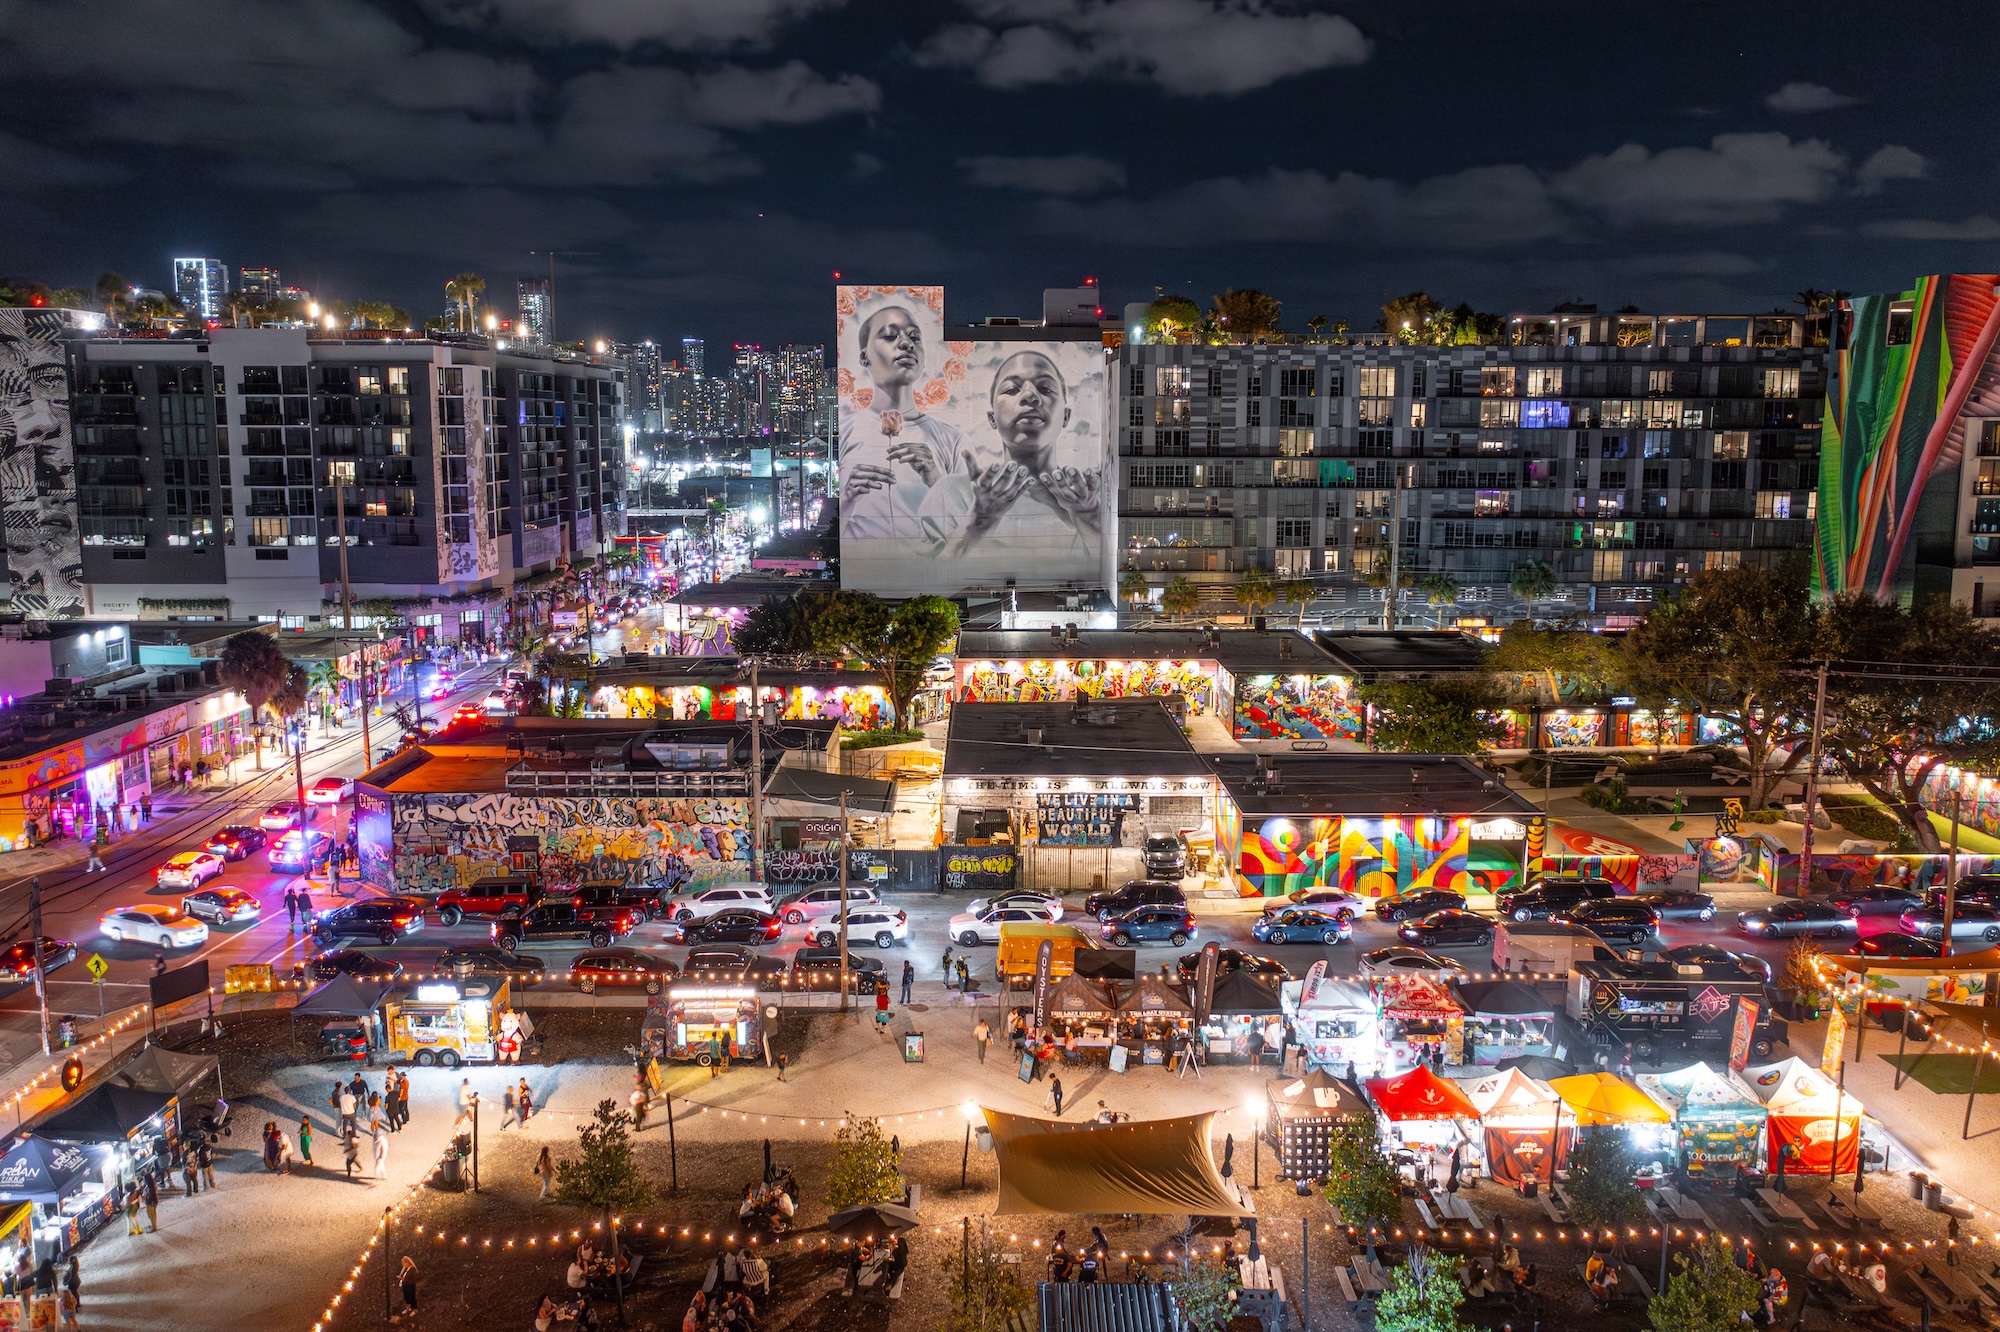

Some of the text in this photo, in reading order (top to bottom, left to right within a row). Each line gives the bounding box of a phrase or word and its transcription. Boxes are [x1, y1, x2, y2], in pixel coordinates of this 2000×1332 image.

[359, 793, 386, 816] COMING
[1040, 794, 1060, 805] WE
[1104, 794, 1119, 806] IN
[1124, 794, 1134, 806] A
[1039, 808, 1117, 822] BEAUTIFUL
[805, 823, 842, 832] ORIGIN
[1044, 823, 1112, 837] WORLD
[1036, 956, 1049, 1027] OYSTERS
[1689, 998, 1731, 1016] EATS
[49, 1146, 81, 1170] URBAN
[2, 1176, 26, 1184] TIKKA
